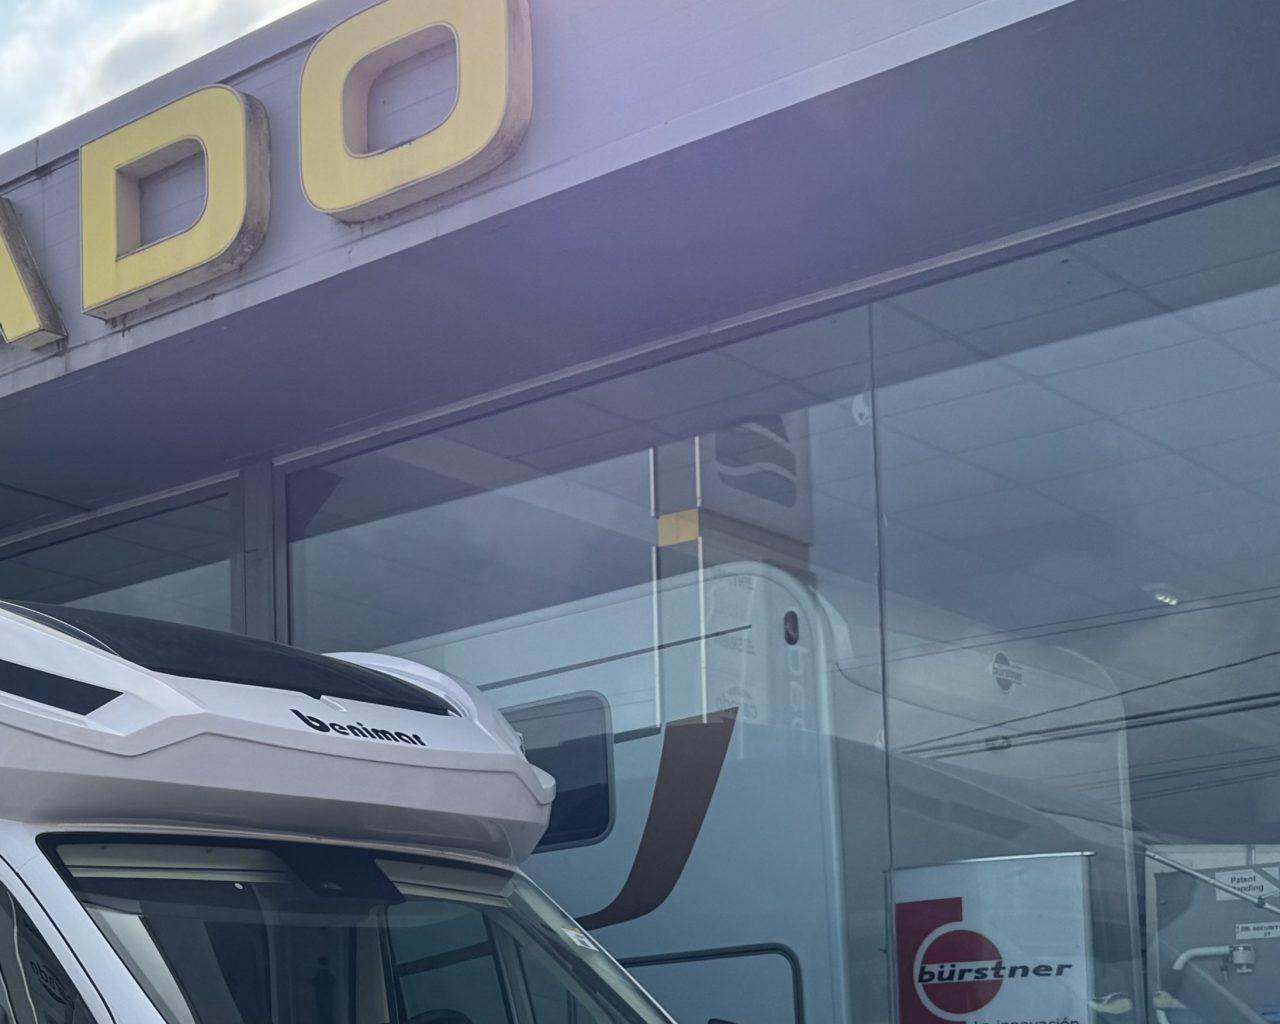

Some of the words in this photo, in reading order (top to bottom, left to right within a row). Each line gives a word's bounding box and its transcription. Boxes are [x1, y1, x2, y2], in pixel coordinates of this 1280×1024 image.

[289, 708, 427, 747] benimar
[1231, 884, 1265, 892] ending
[918, 960, 1073, 983] bürstner
